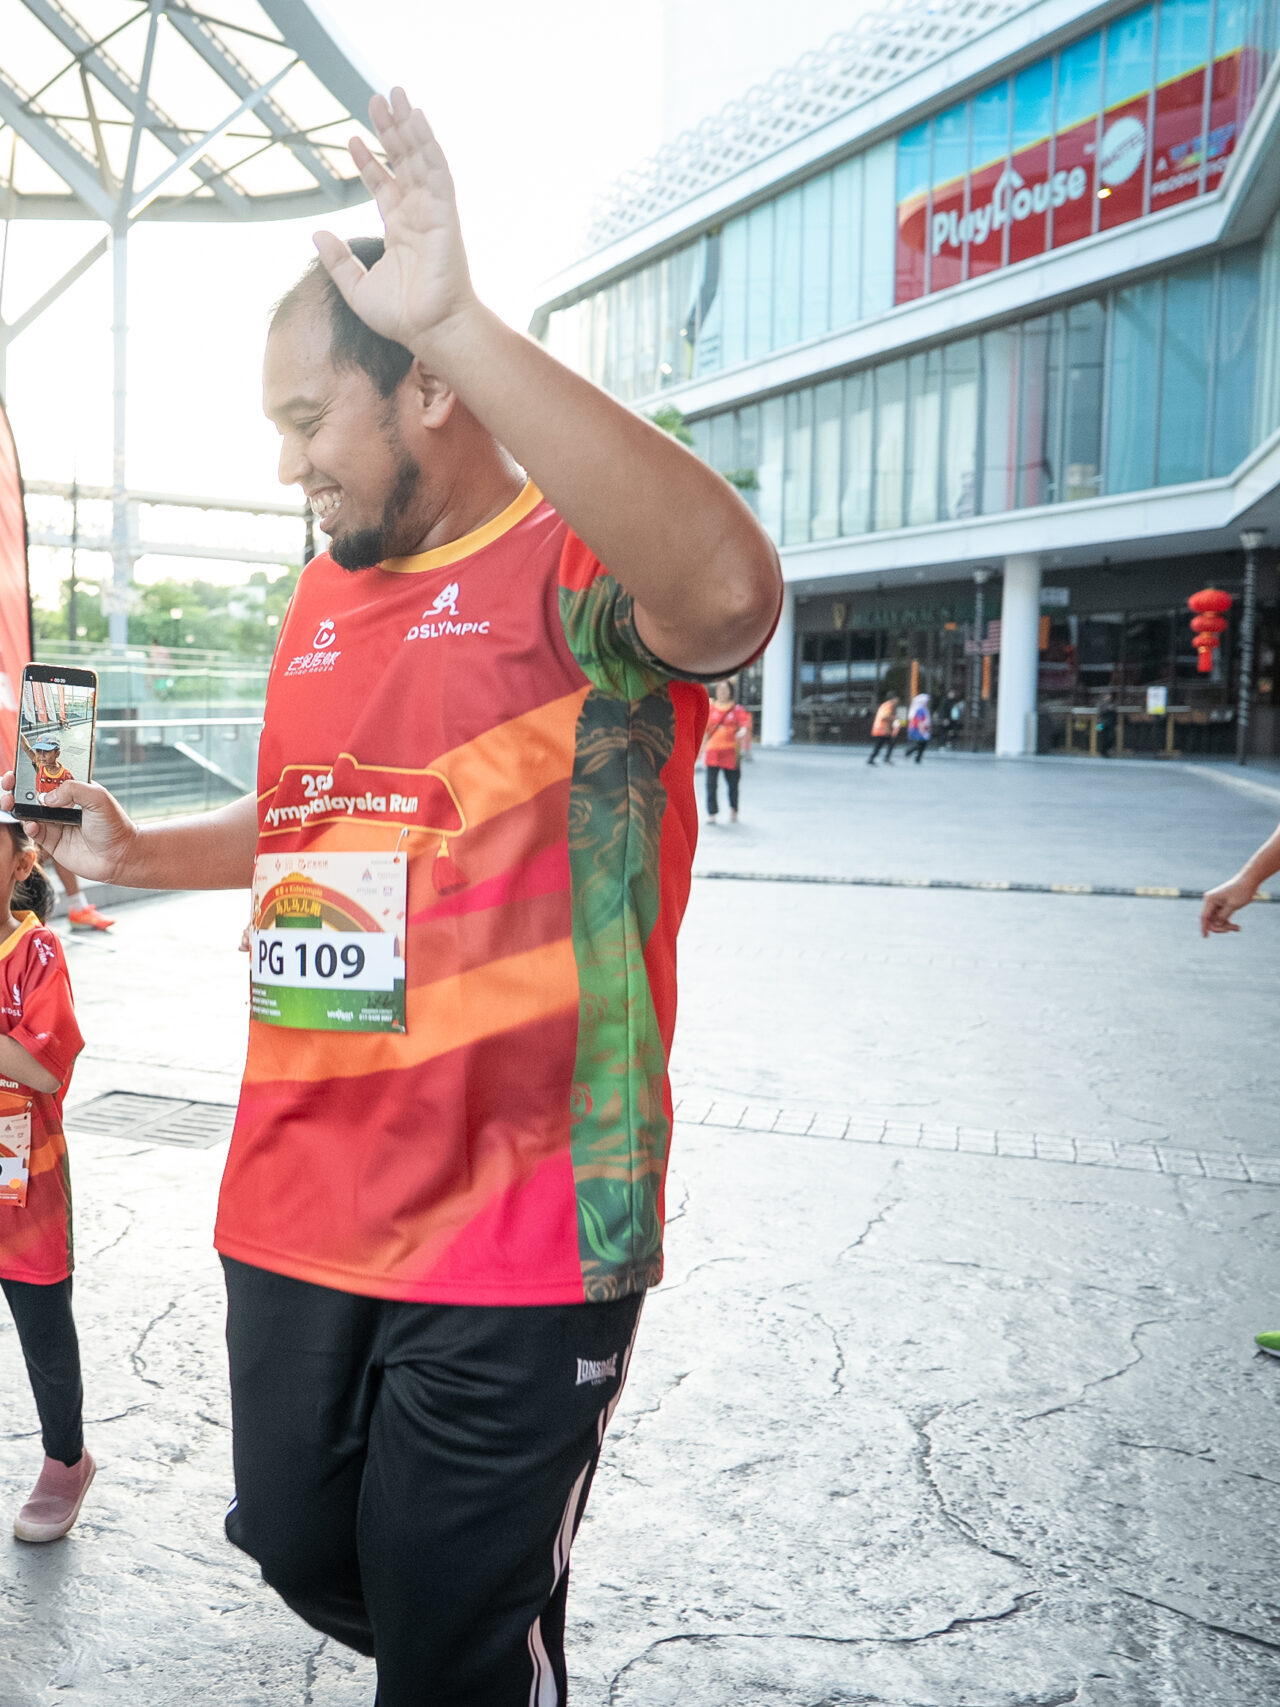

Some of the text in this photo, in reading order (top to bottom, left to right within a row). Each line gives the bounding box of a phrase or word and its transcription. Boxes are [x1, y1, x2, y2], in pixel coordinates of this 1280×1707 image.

[404, 621, 490, 642] DSLYMPIC
[389, 793, 418, 812] Run
[259, 939, 365, 979] PG 109
[0, 1079, 19, 1089] Run
